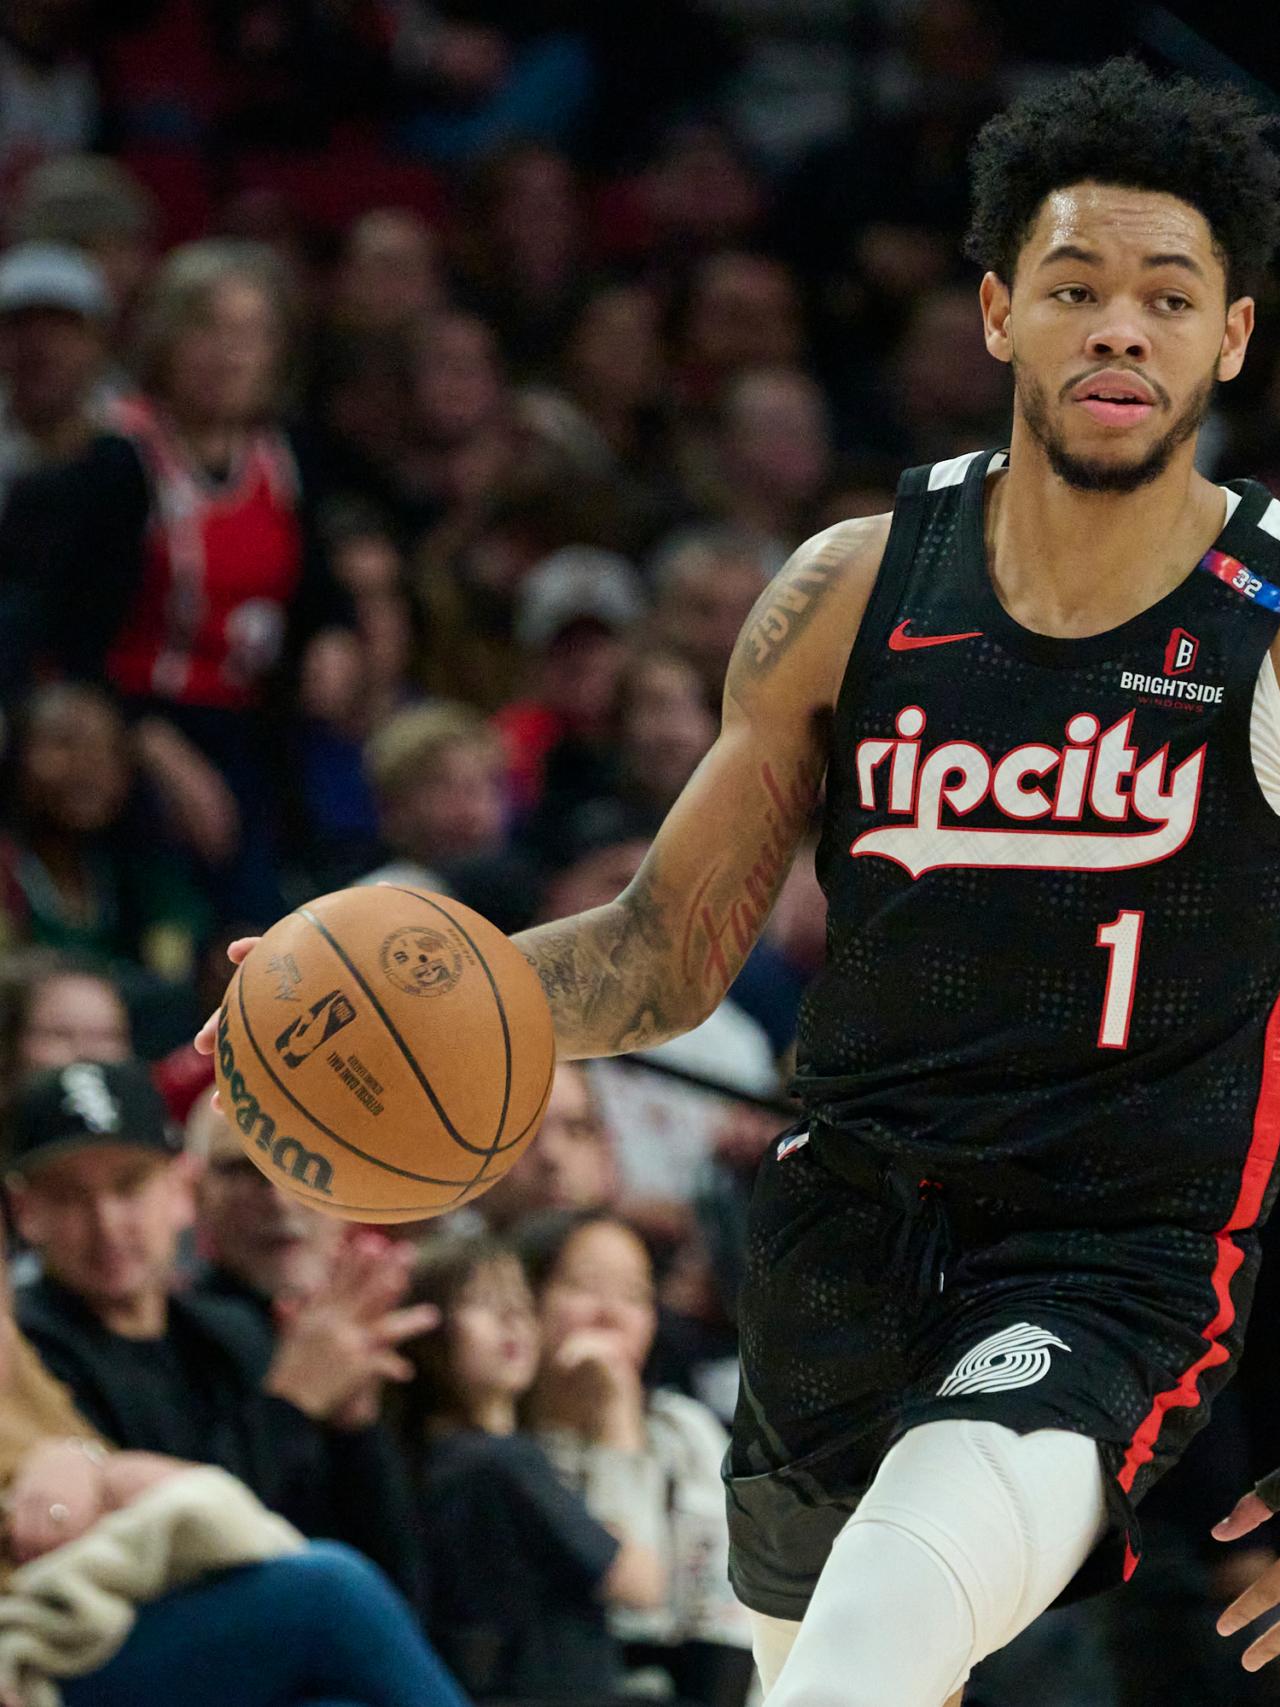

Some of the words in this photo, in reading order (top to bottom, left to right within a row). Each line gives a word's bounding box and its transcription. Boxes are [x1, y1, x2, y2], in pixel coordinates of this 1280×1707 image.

[1232, 569, 1263, 599] 32
[1119, 671, 1225, 704] BRIGHTSIDE
[1137, 695, 1205, 714] WINDOWS
[1096, 909, 1145, 1050] 1
